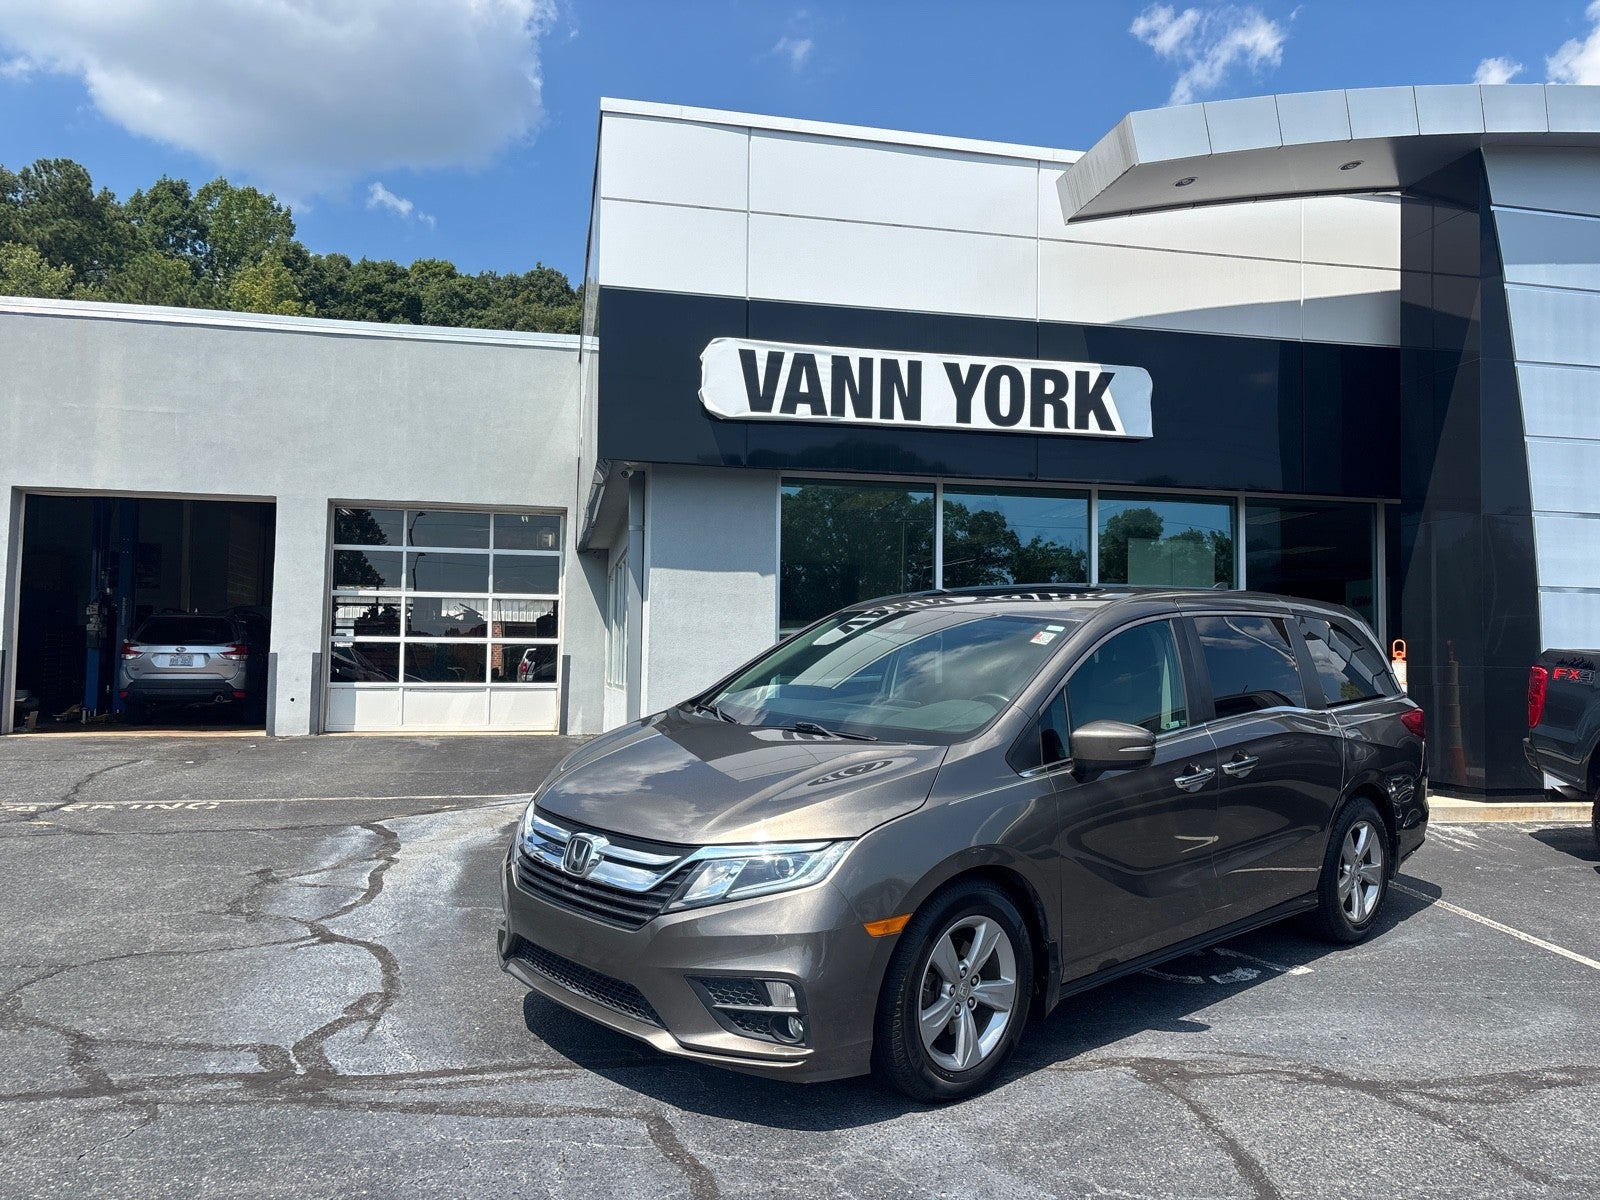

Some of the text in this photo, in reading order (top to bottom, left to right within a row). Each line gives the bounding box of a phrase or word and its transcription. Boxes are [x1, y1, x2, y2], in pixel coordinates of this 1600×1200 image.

[738, 349, 1117, 432] VANN YORK
[1553, 667, 1595, 683] FX4
